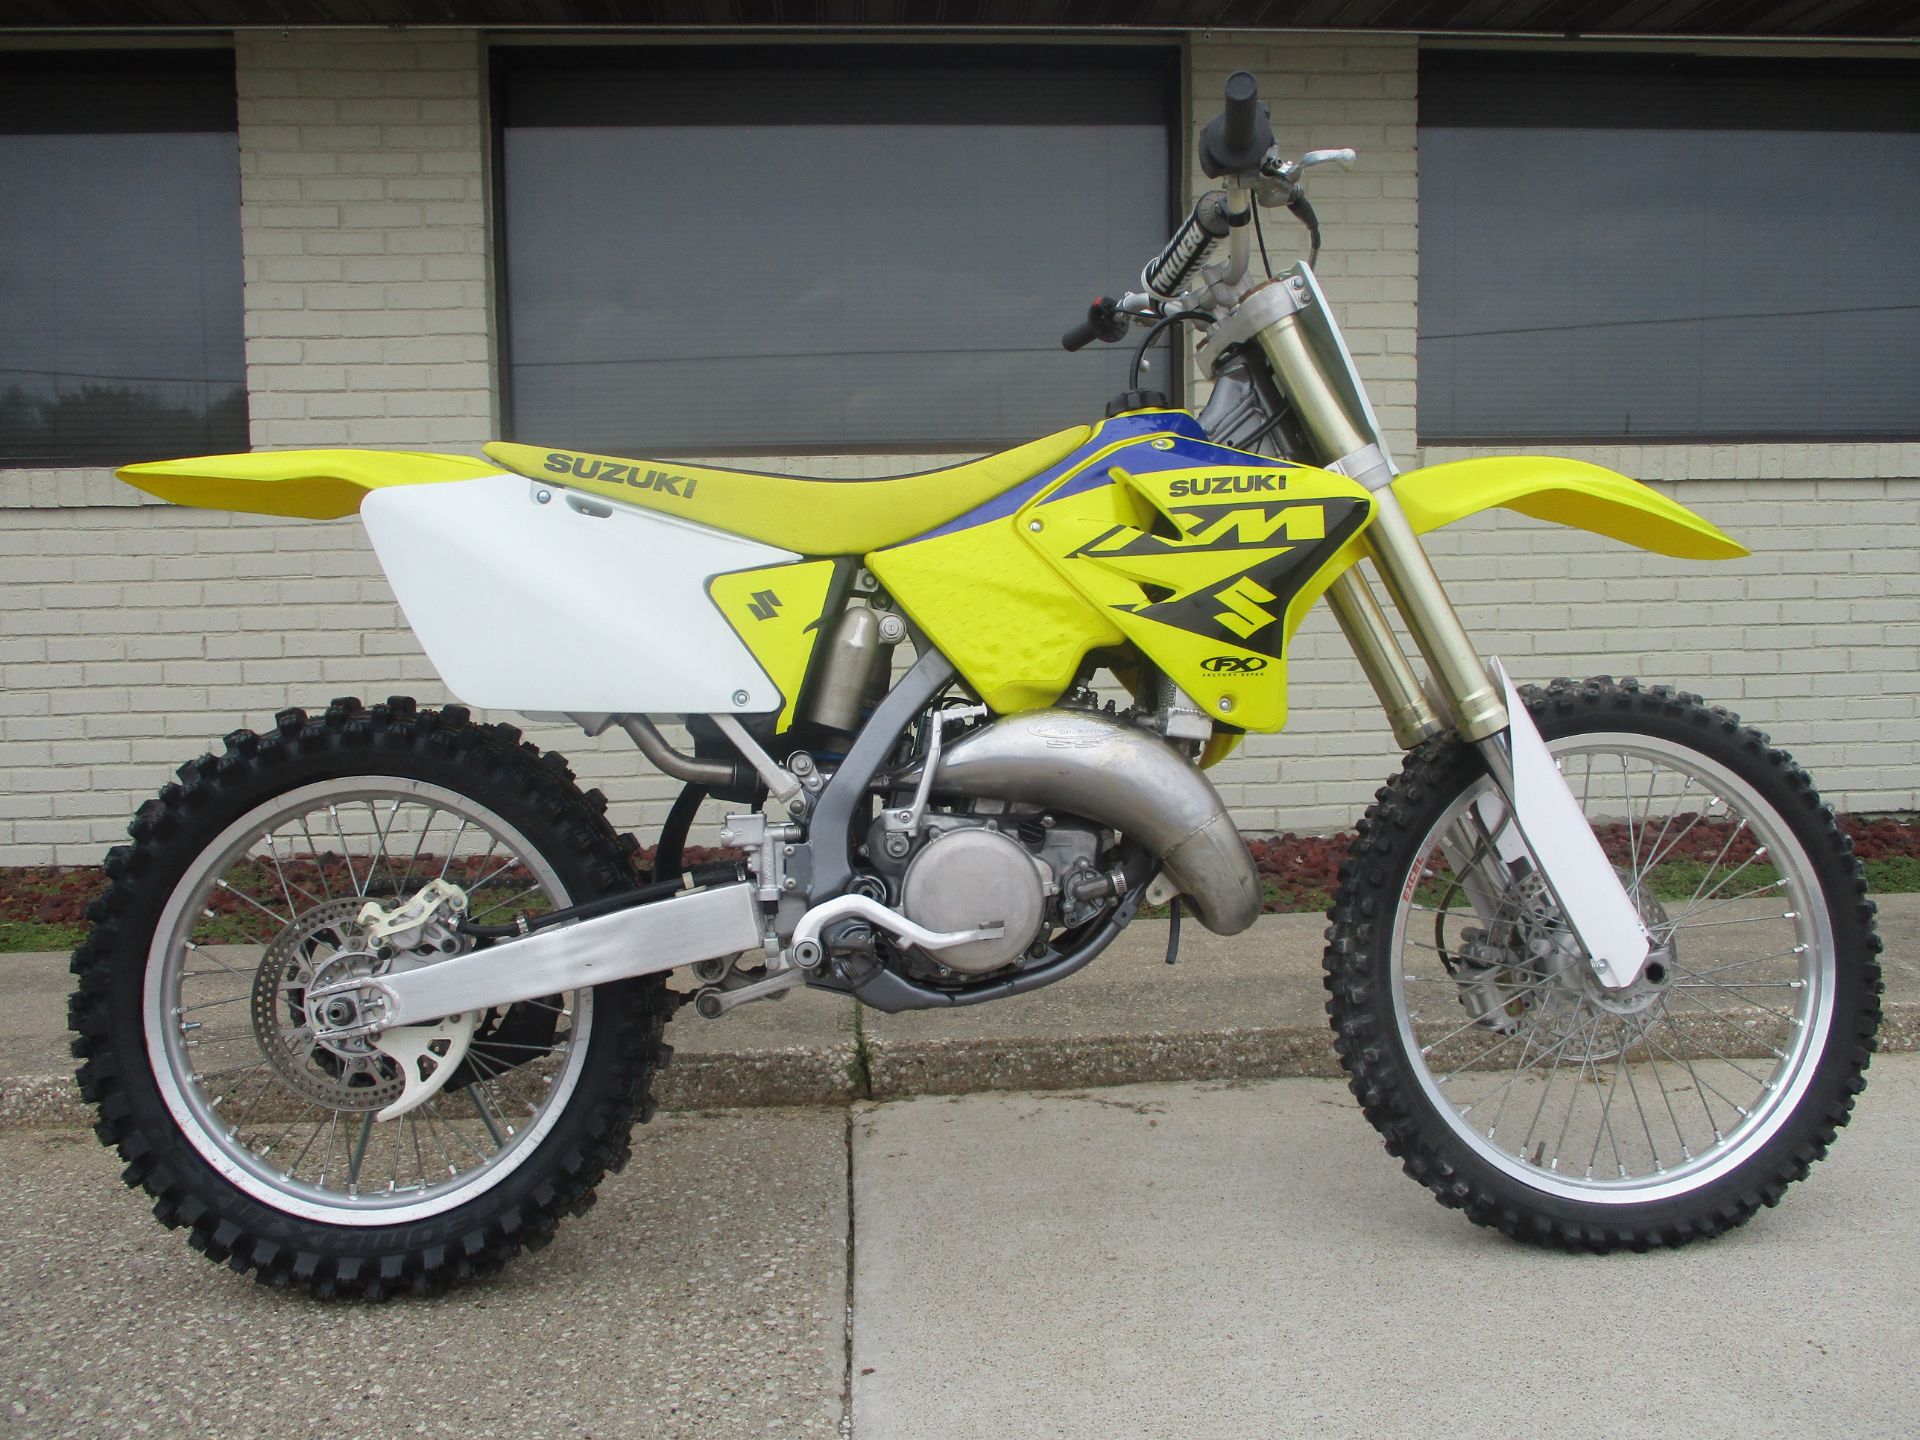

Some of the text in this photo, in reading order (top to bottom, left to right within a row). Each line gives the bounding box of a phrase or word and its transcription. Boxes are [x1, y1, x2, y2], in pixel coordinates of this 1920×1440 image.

[1151, 220, 1205, 293] RENTHAL
[543, 452, 698, 500] SUZUKI
[1169, 474, 1287, 497] SUZUKI
[1211, 656, 1257, 672] FX
[1401, 857, 1425, 903] EXCEL
